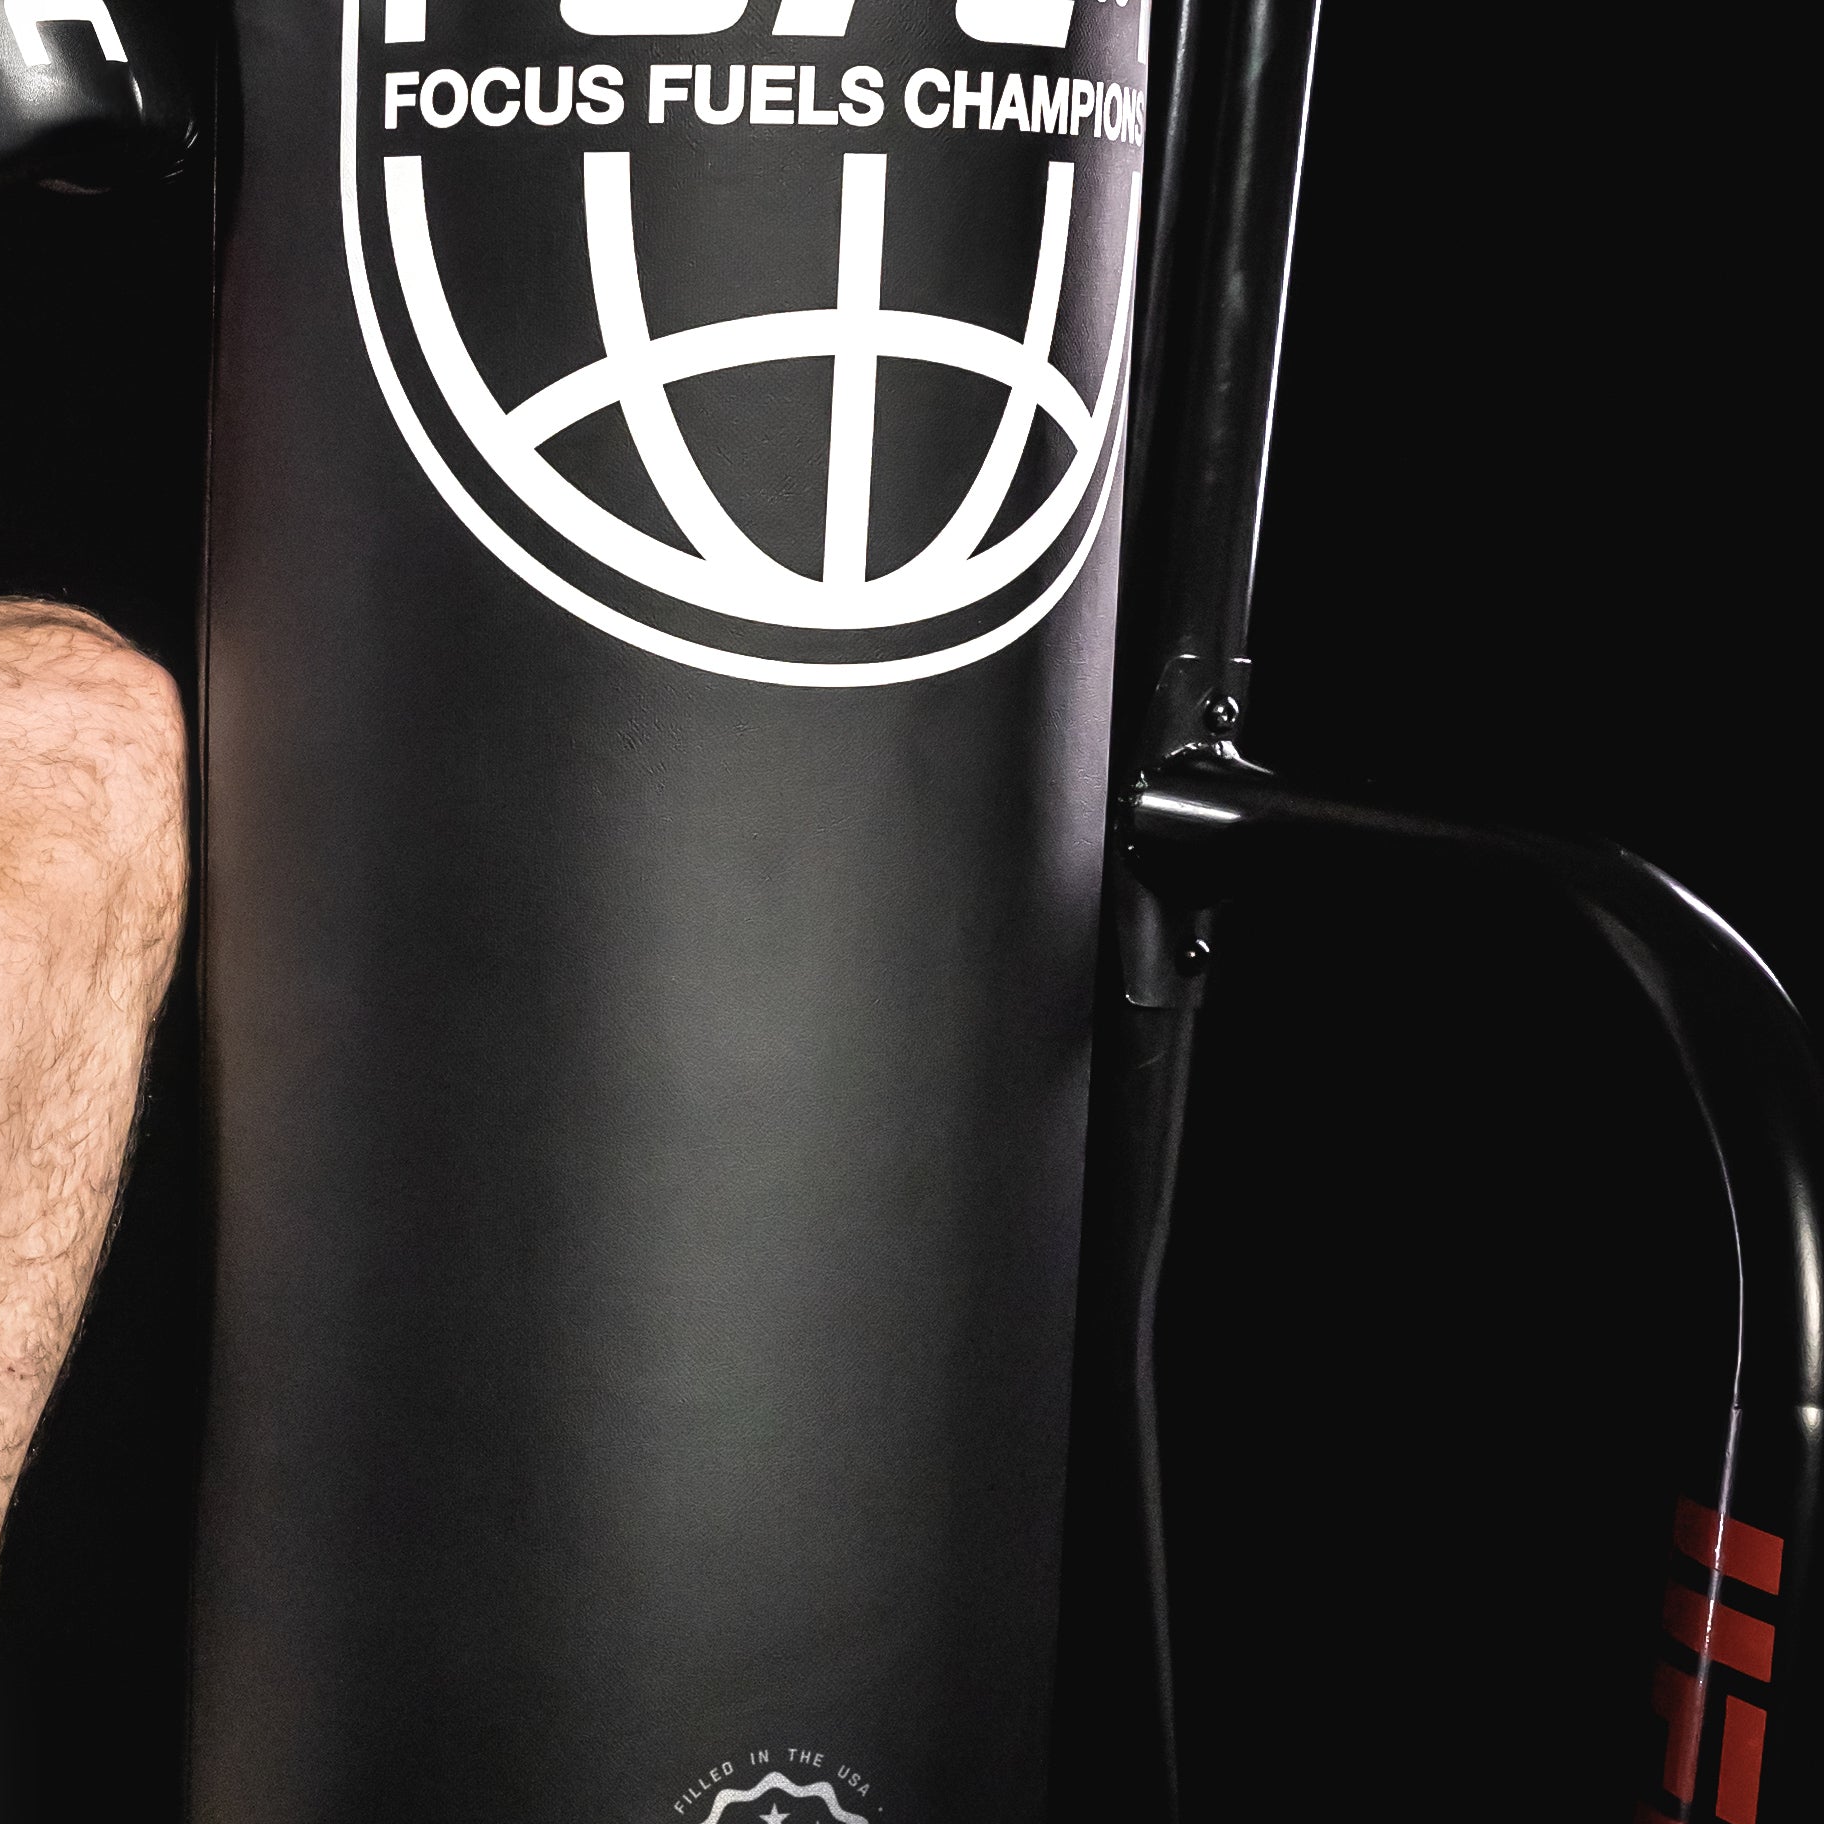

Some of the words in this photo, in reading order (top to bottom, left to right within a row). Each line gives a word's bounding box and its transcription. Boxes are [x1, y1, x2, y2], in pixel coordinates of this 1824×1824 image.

[383, 65, 625, 130] FOCUS
[648, 64, 886, 127] FUELS
[903, 66, 1146, 148] CHAMPIONS
[673, 1760, 735, 1816] FILLED
[749, 1748, 770, 1766] IN
[787, 1747, 825, 1769] THE
[836, 1764, 871, 1798] USA
